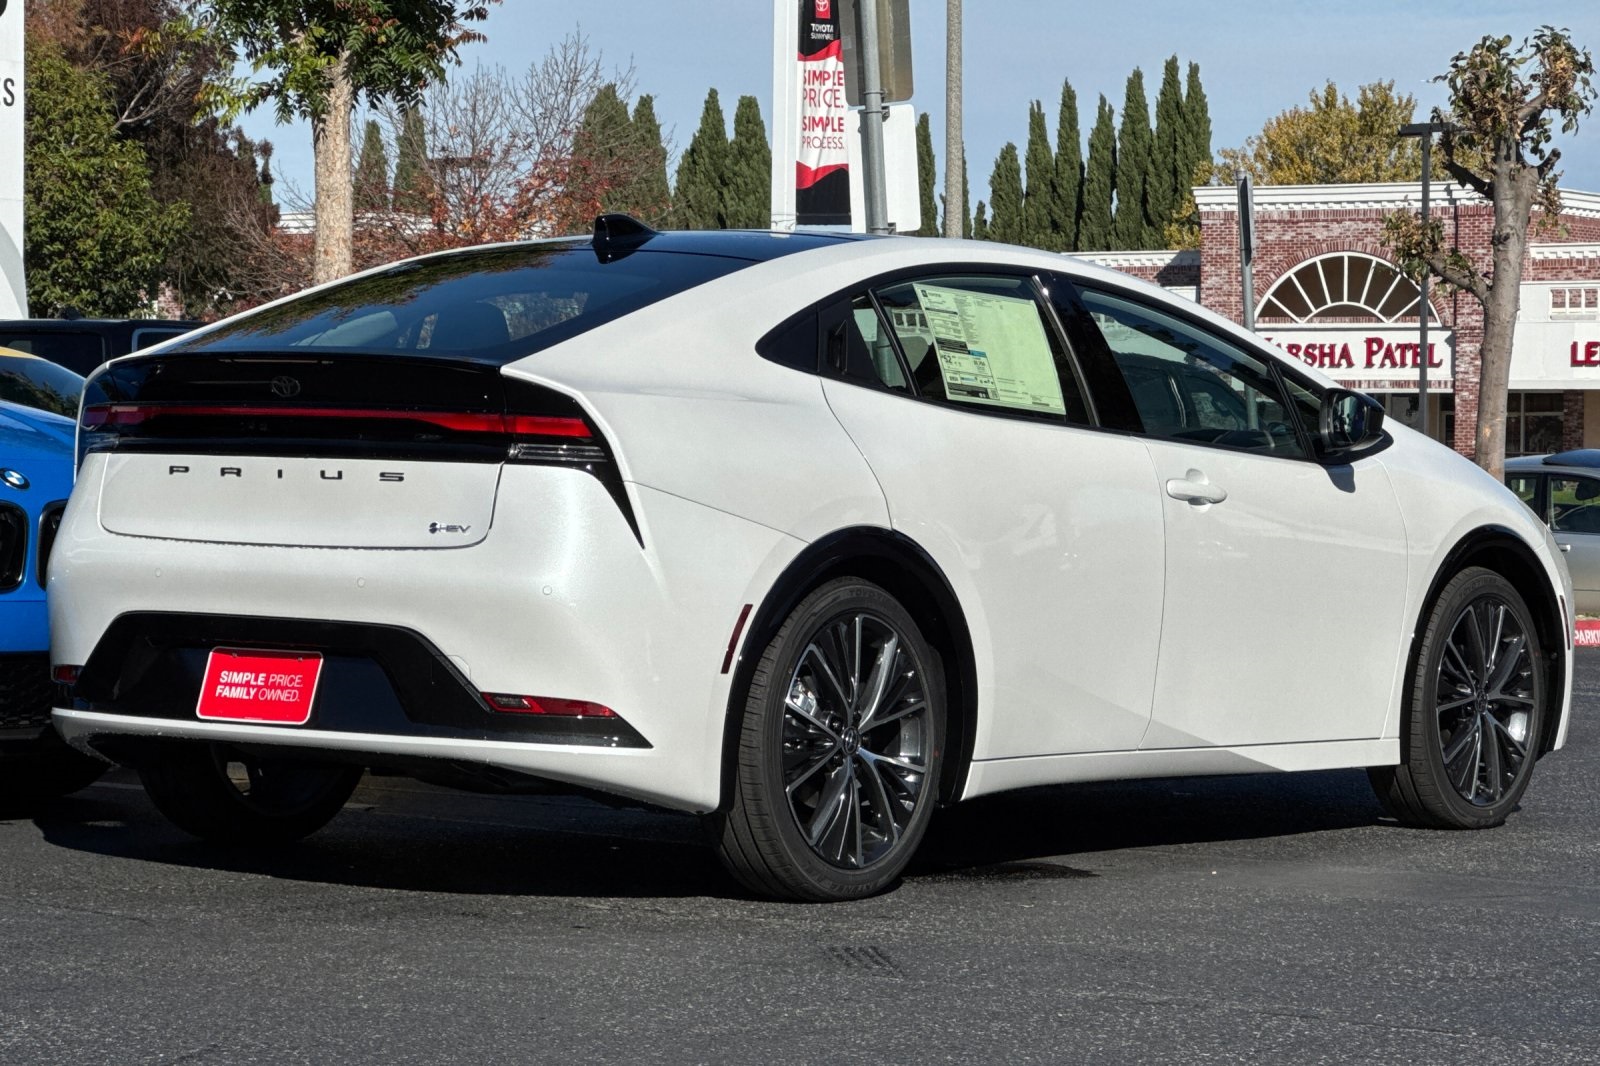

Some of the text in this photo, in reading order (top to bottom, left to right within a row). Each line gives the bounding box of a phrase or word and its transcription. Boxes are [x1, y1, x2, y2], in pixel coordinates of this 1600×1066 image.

[810, 24, 834, 32] TOYOTA
[803, 70, 844, 86] SIMPLE
[803, 88, 844, 108] PRICE.
[802, 116, 845, 132] SIMPLE
[802, 136, 845, 149] PROCESS.
[1264, 337, 1444, 369] RSHA PATEL
[169, 465, 404, 482] PRIUS
[220, 670, 304, 688] SIMPLE PRICE.
[215, 685, 300, 702] FAMILY OWNED.
